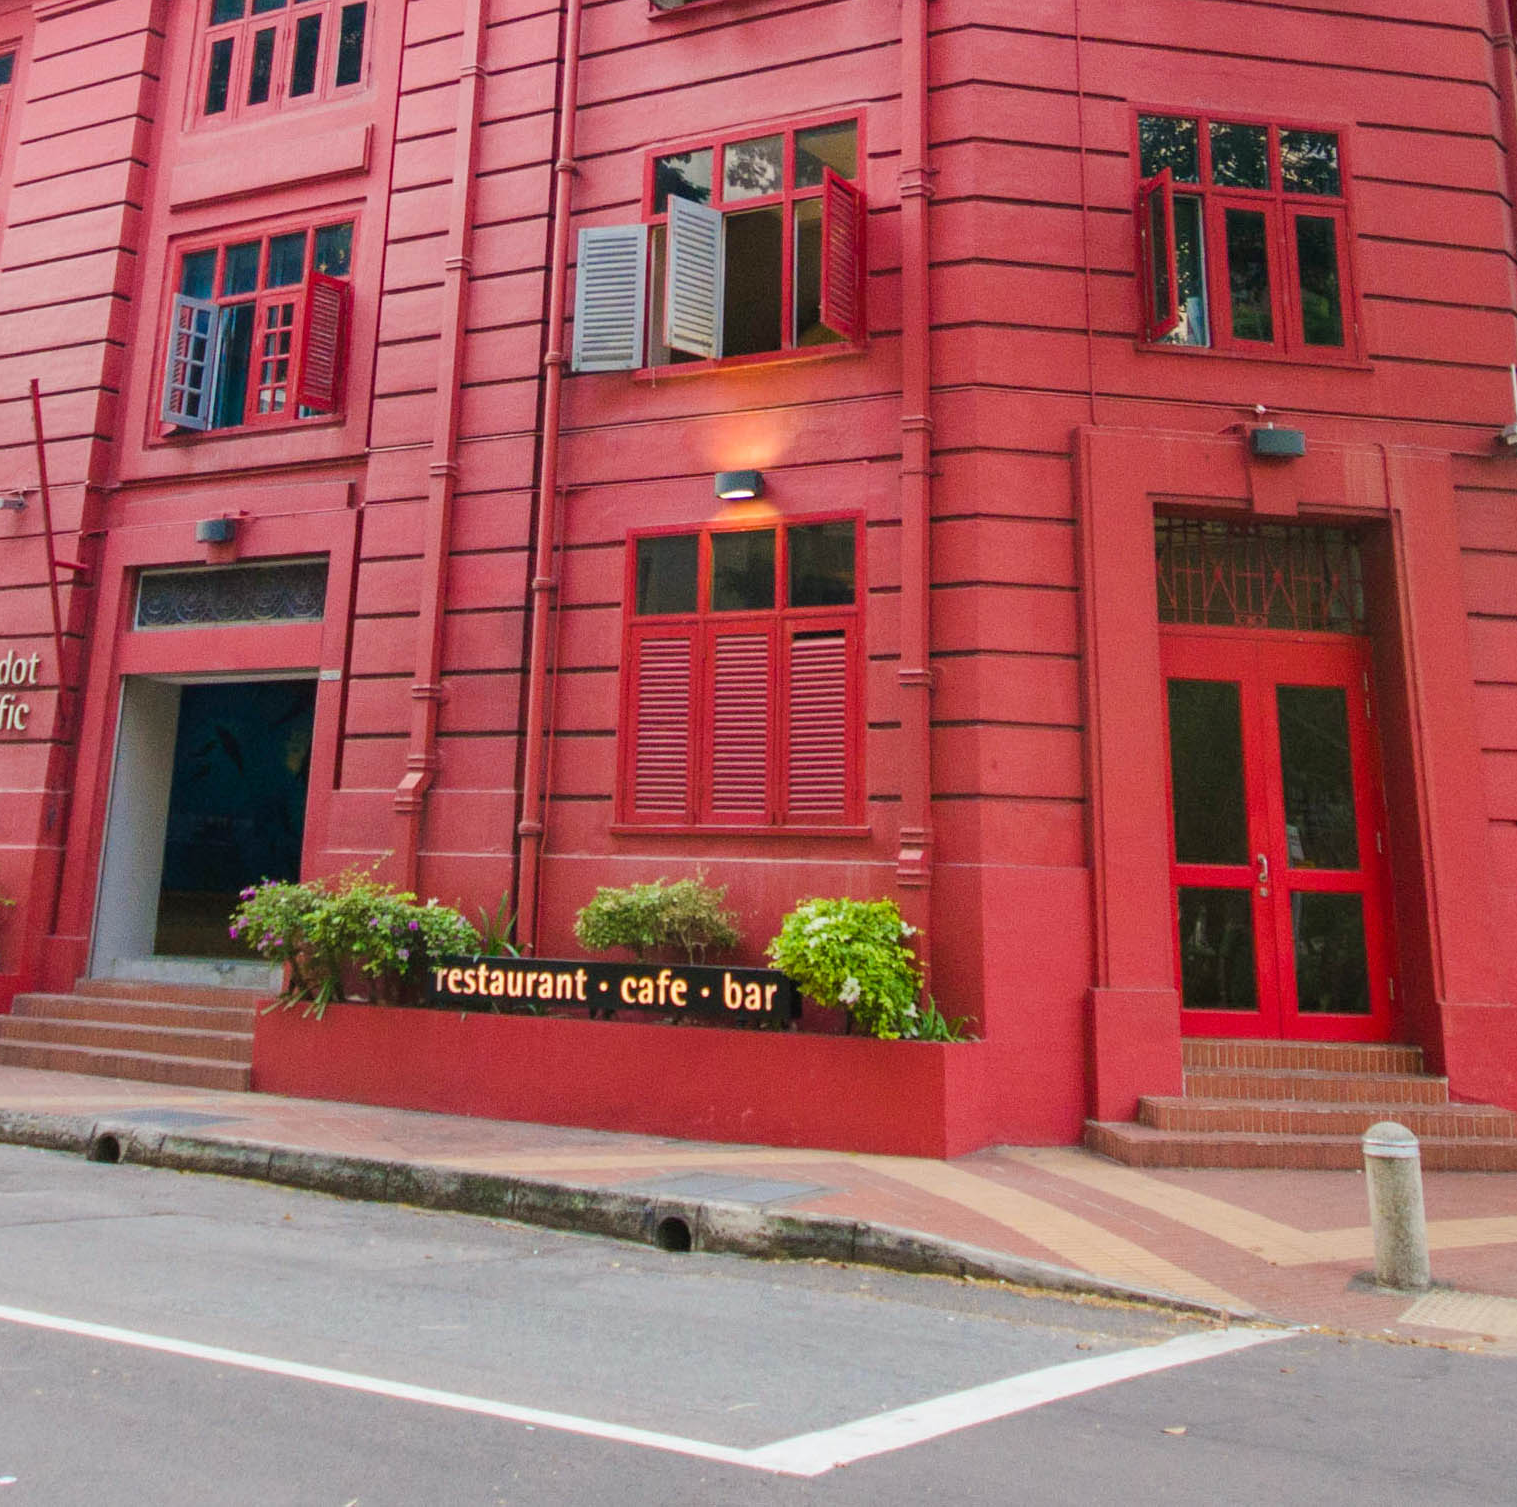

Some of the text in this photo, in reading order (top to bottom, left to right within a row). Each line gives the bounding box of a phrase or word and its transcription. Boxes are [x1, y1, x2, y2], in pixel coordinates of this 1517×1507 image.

[435, 964, 778, 1012] restaurant cafe bar
